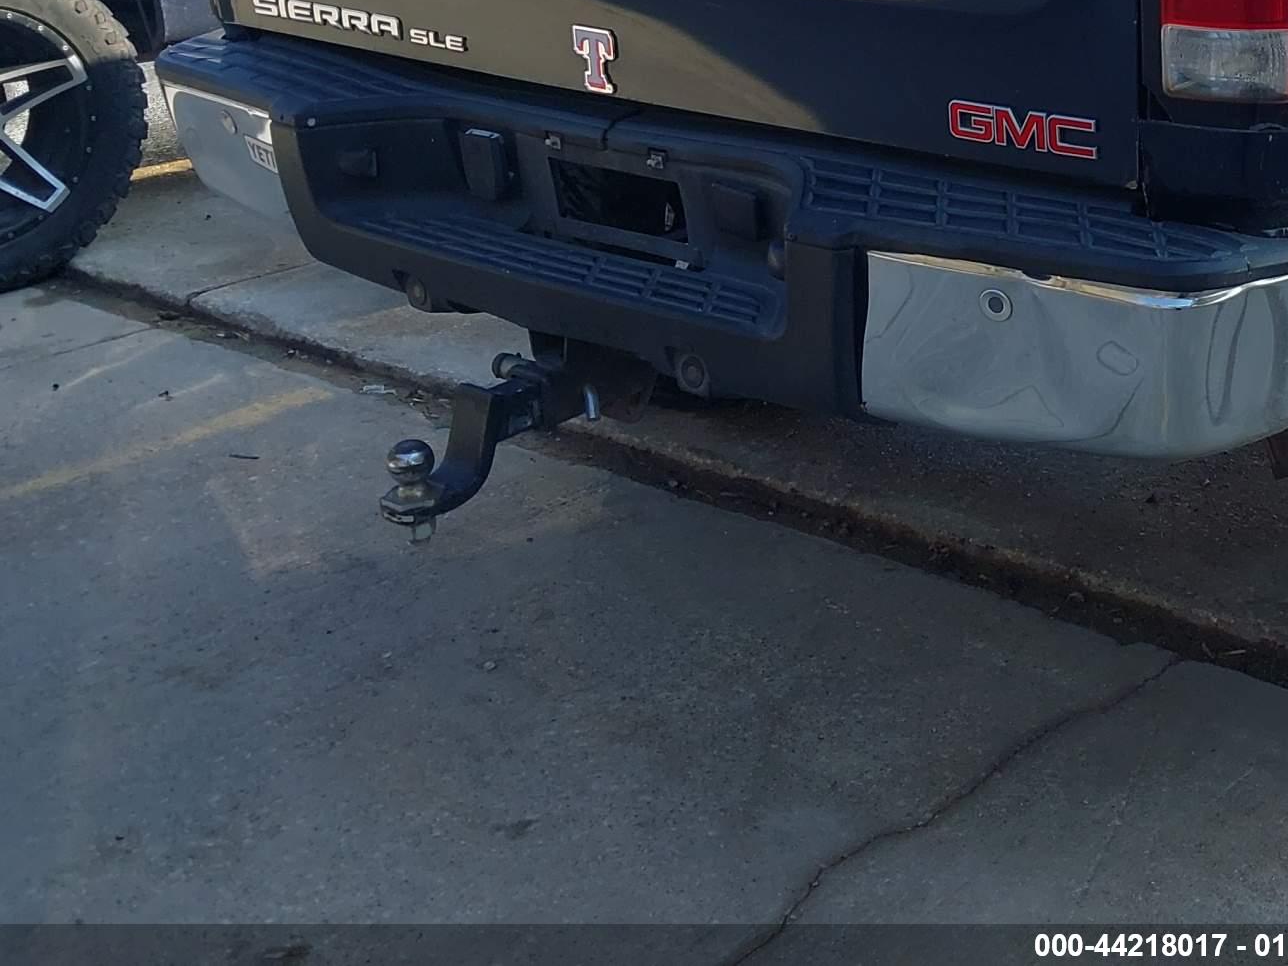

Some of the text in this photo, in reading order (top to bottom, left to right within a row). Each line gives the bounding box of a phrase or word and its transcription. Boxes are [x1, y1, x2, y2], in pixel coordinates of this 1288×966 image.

[409, 28, 467, 52] SLE
[572, 24, 615, 94] T
[948, 99, 1097, 159] GMC
